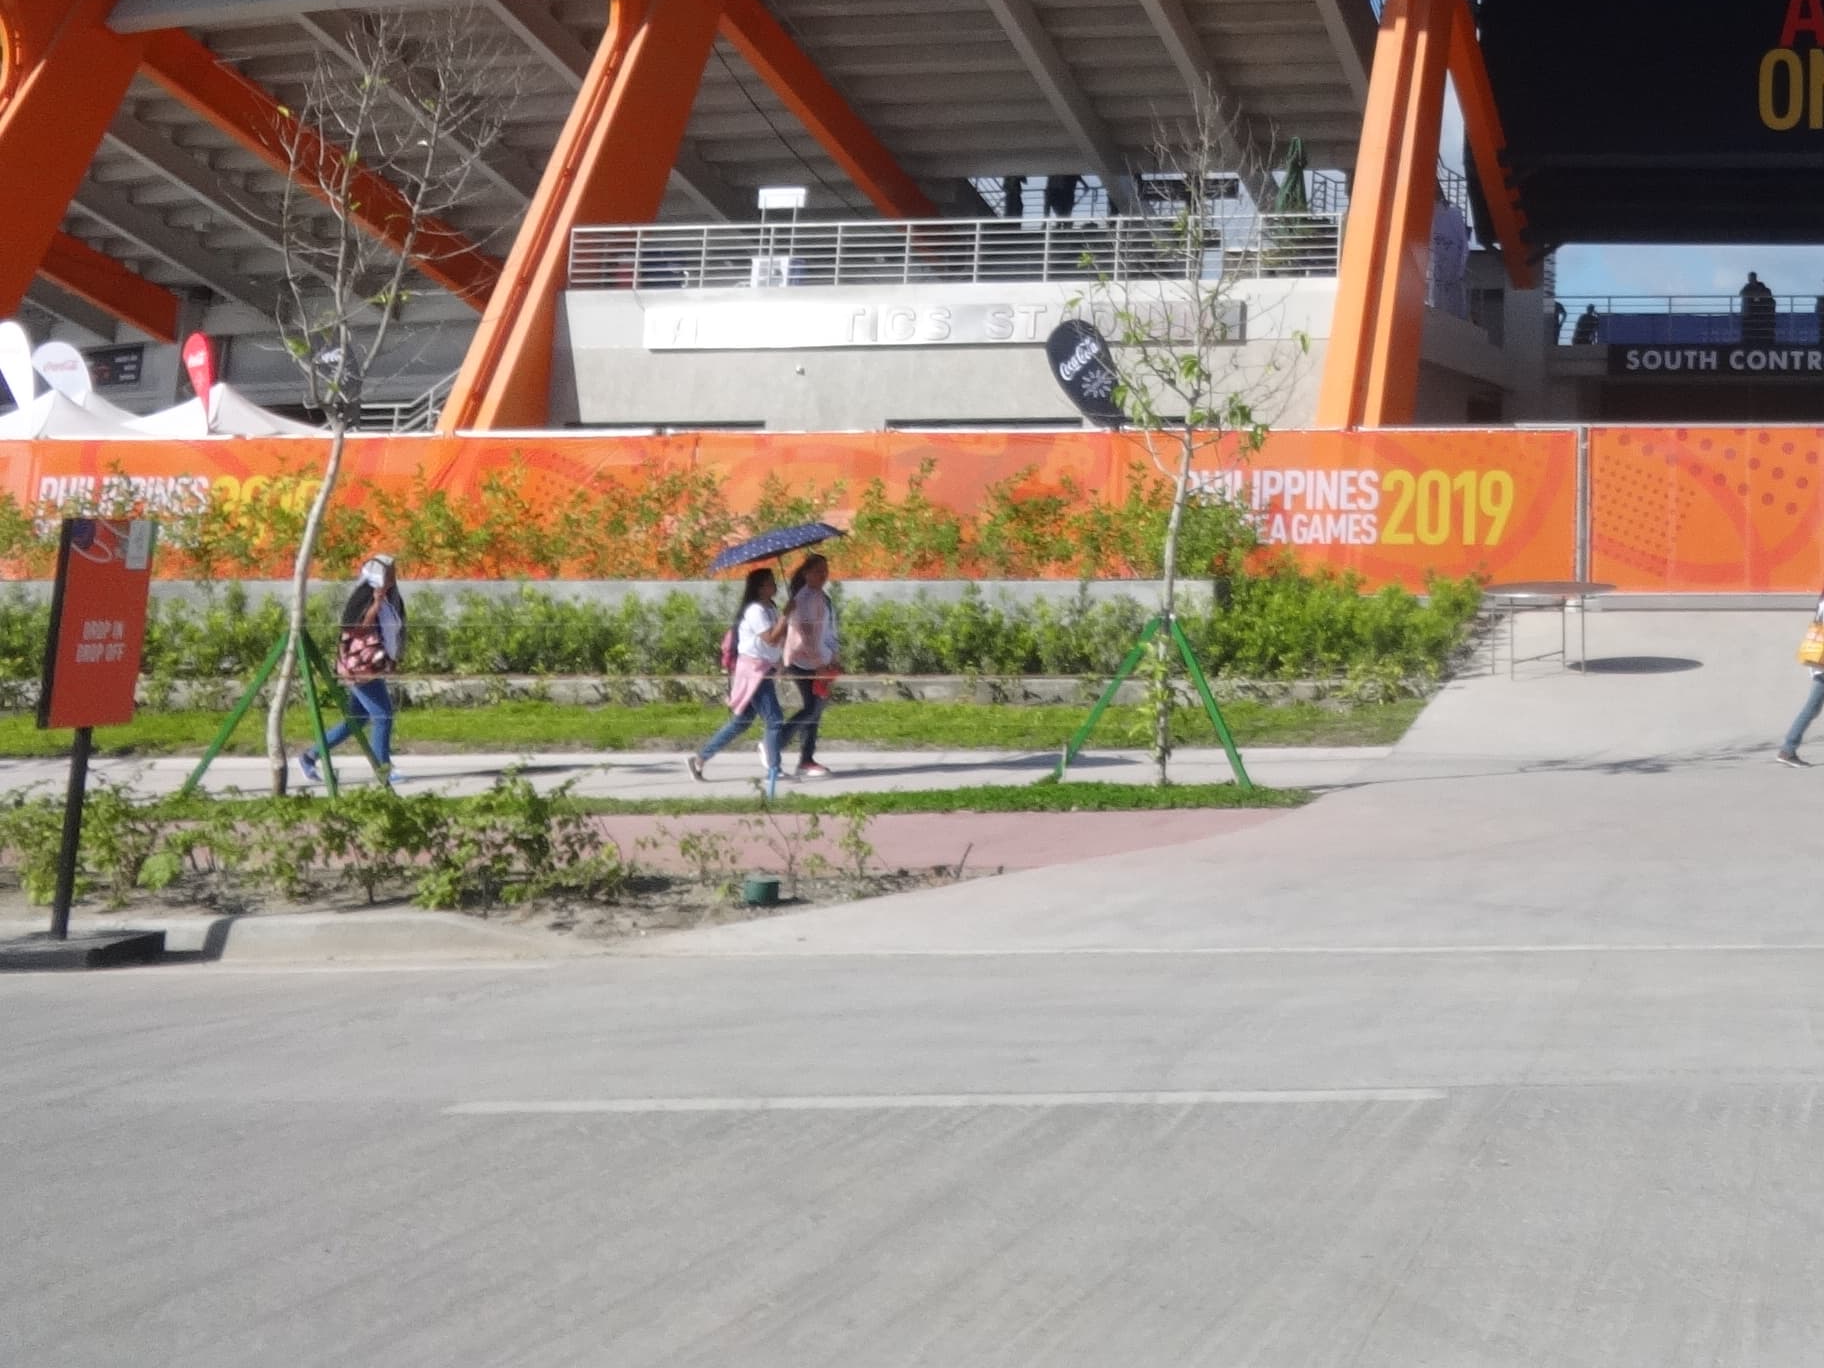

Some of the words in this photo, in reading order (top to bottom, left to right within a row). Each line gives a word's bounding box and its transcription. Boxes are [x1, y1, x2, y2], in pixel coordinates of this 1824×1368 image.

[1625, 349, 1718, 371] SOUTH
[1380, 468, 1515, 547] 2019
[1291, 513, 1378, 545] GAMES
